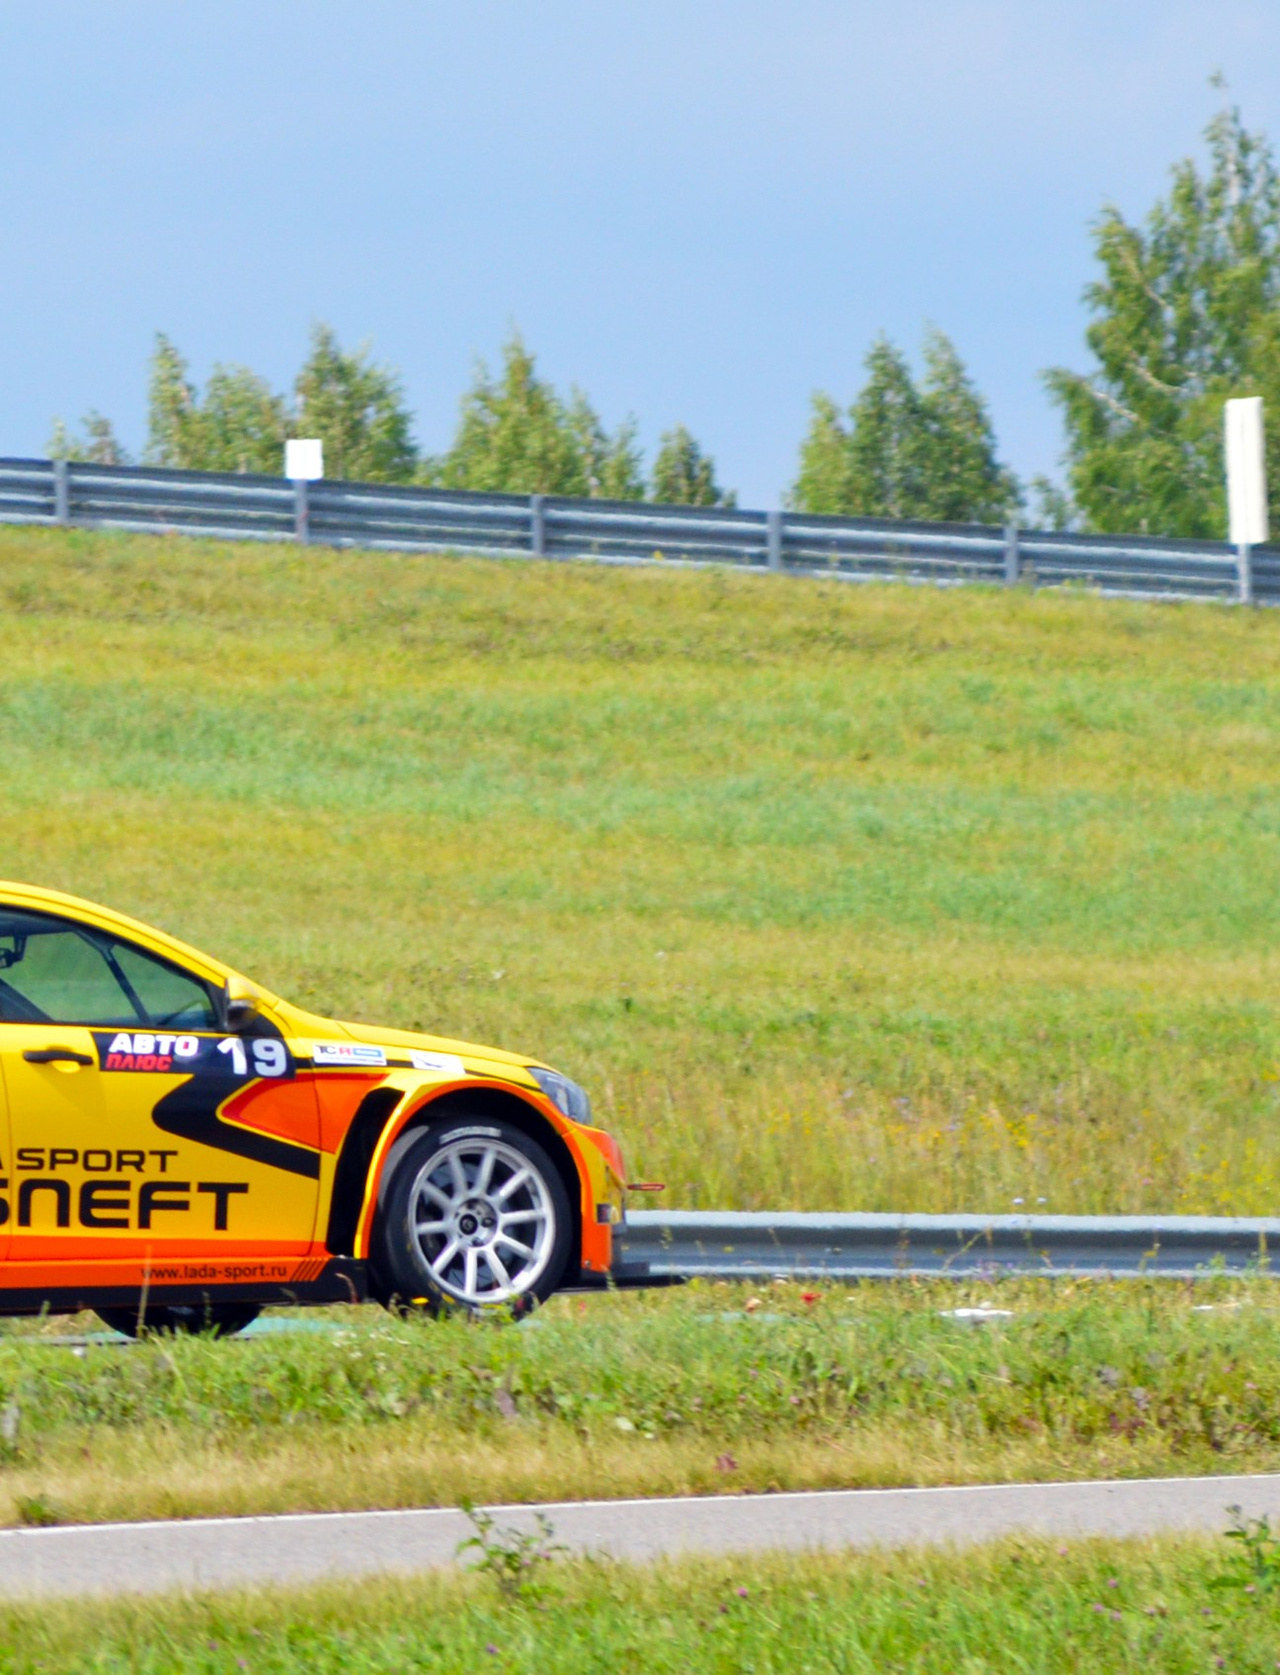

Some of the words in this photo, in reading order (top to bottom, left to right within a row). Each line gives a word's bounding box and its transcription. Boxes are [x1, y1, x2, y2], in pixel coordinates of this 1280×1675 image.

[108, 1033, 199, 1057] АВТО
[217, 1037, 287, 1077] 19
[105, 1054, 173, 1071] ПЛЮС
[17, 1148, 178, 1173] SPORT
[141, 1265, 287, 1280] www.lada-sport.ru
